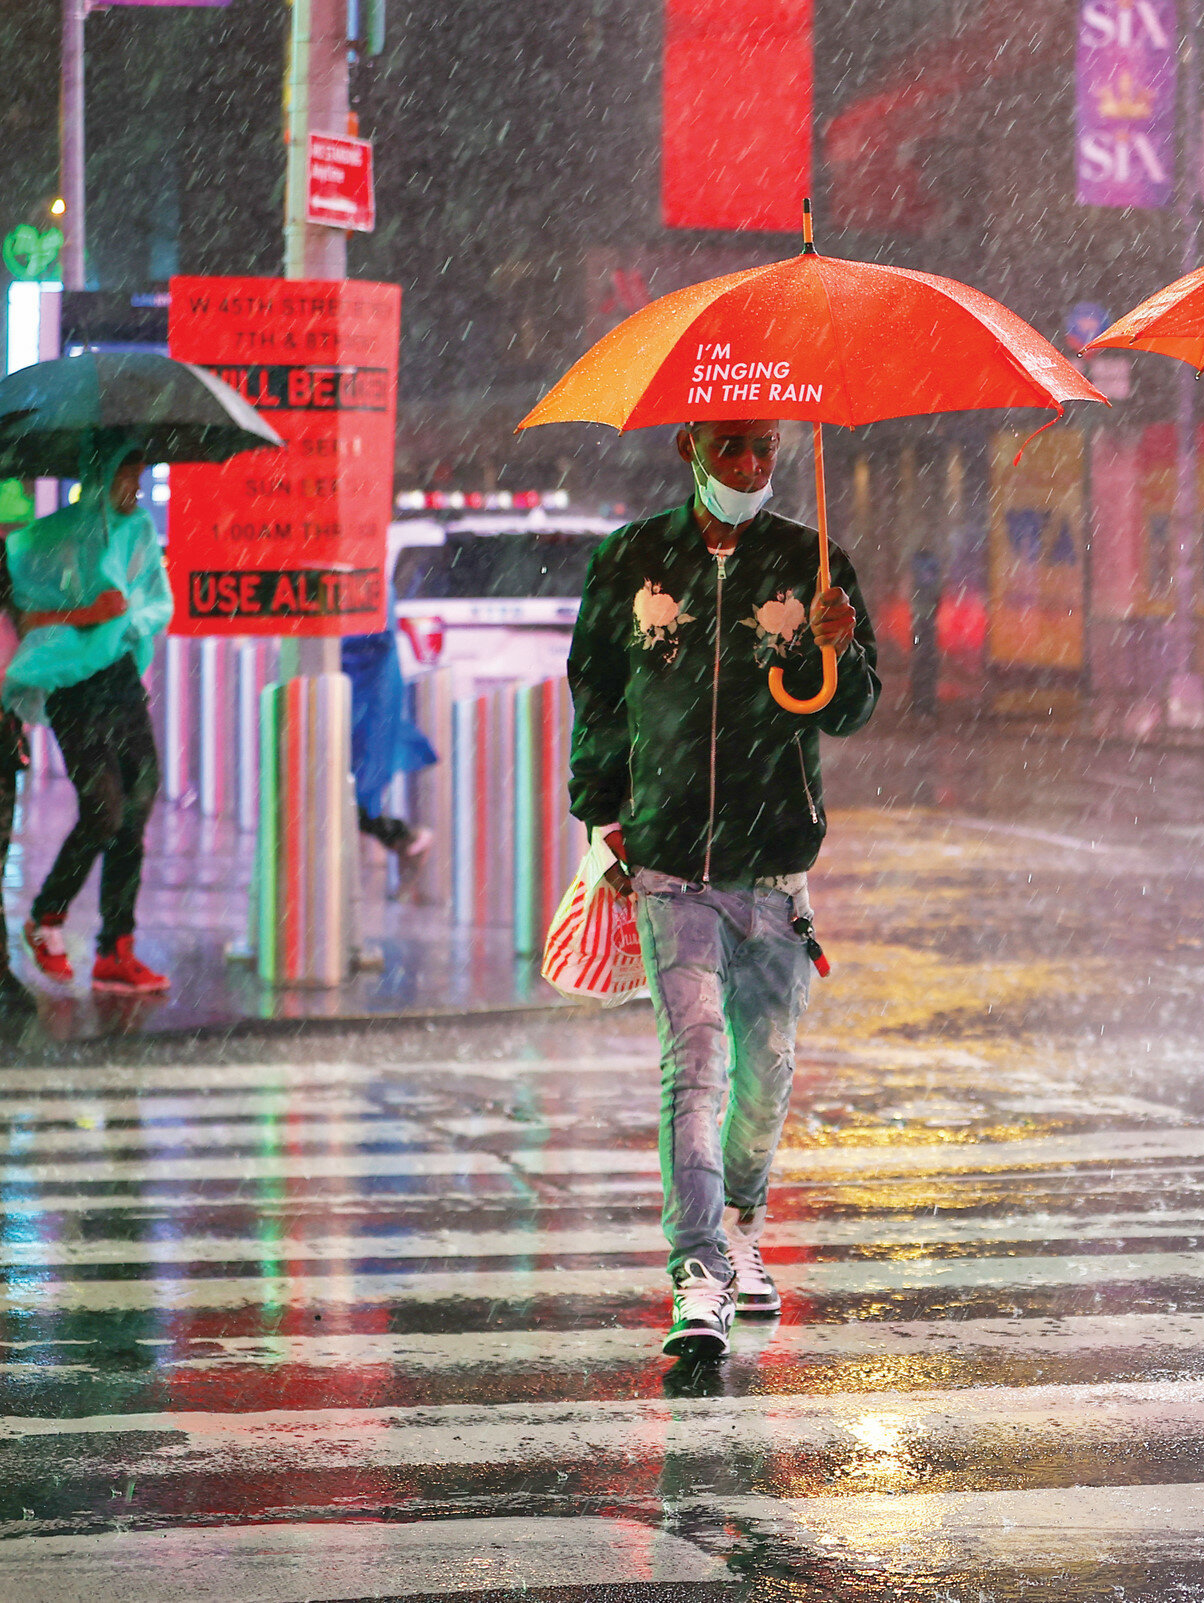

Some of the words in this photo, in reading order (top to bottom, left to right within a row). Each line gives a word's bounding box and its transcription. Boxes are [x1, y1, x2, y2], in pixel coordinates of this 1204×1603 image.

[189, 297, 211, 315] W
[217, 297, 274, 316] 45TH
[234, 331, 276, 349] 7TH
[696, 343, 731, 360] I'M
[691, 361, 790, 382] SINGING
[288, 368, 336, 407] BE
[687, 386, 713, 404] IN
[722, 384, 761, 402] THE
[768, 383, 823, 403] RAIN
[192, 574, 262, 613] USE
